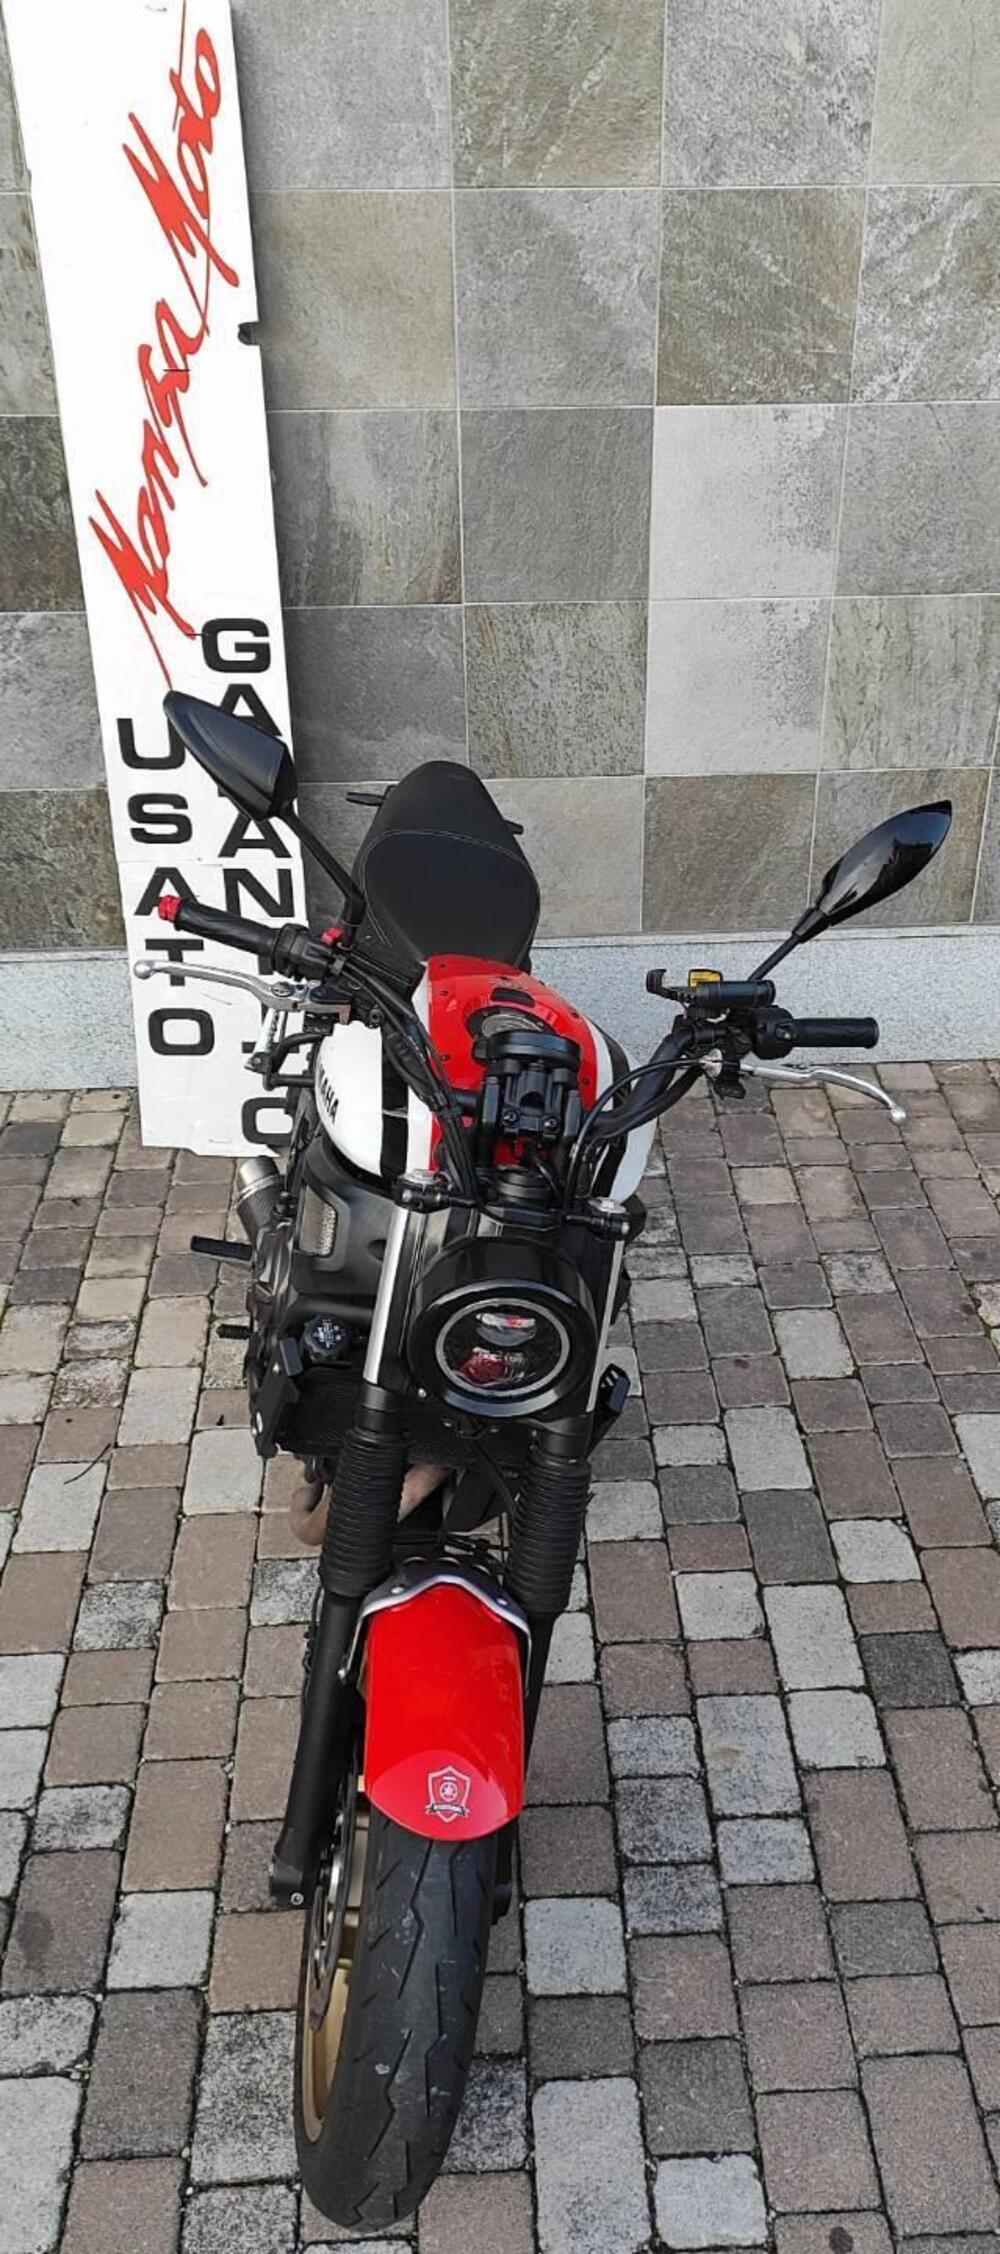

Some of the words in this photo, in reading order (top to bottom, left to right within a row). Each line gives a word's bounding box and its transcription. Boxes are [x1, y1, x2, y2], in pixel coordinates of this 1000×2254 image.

[122, 0, 239, 334] Moto
[116, 718, 215, 1056] USATO
[201, 618, 300, 1146] GAANO
